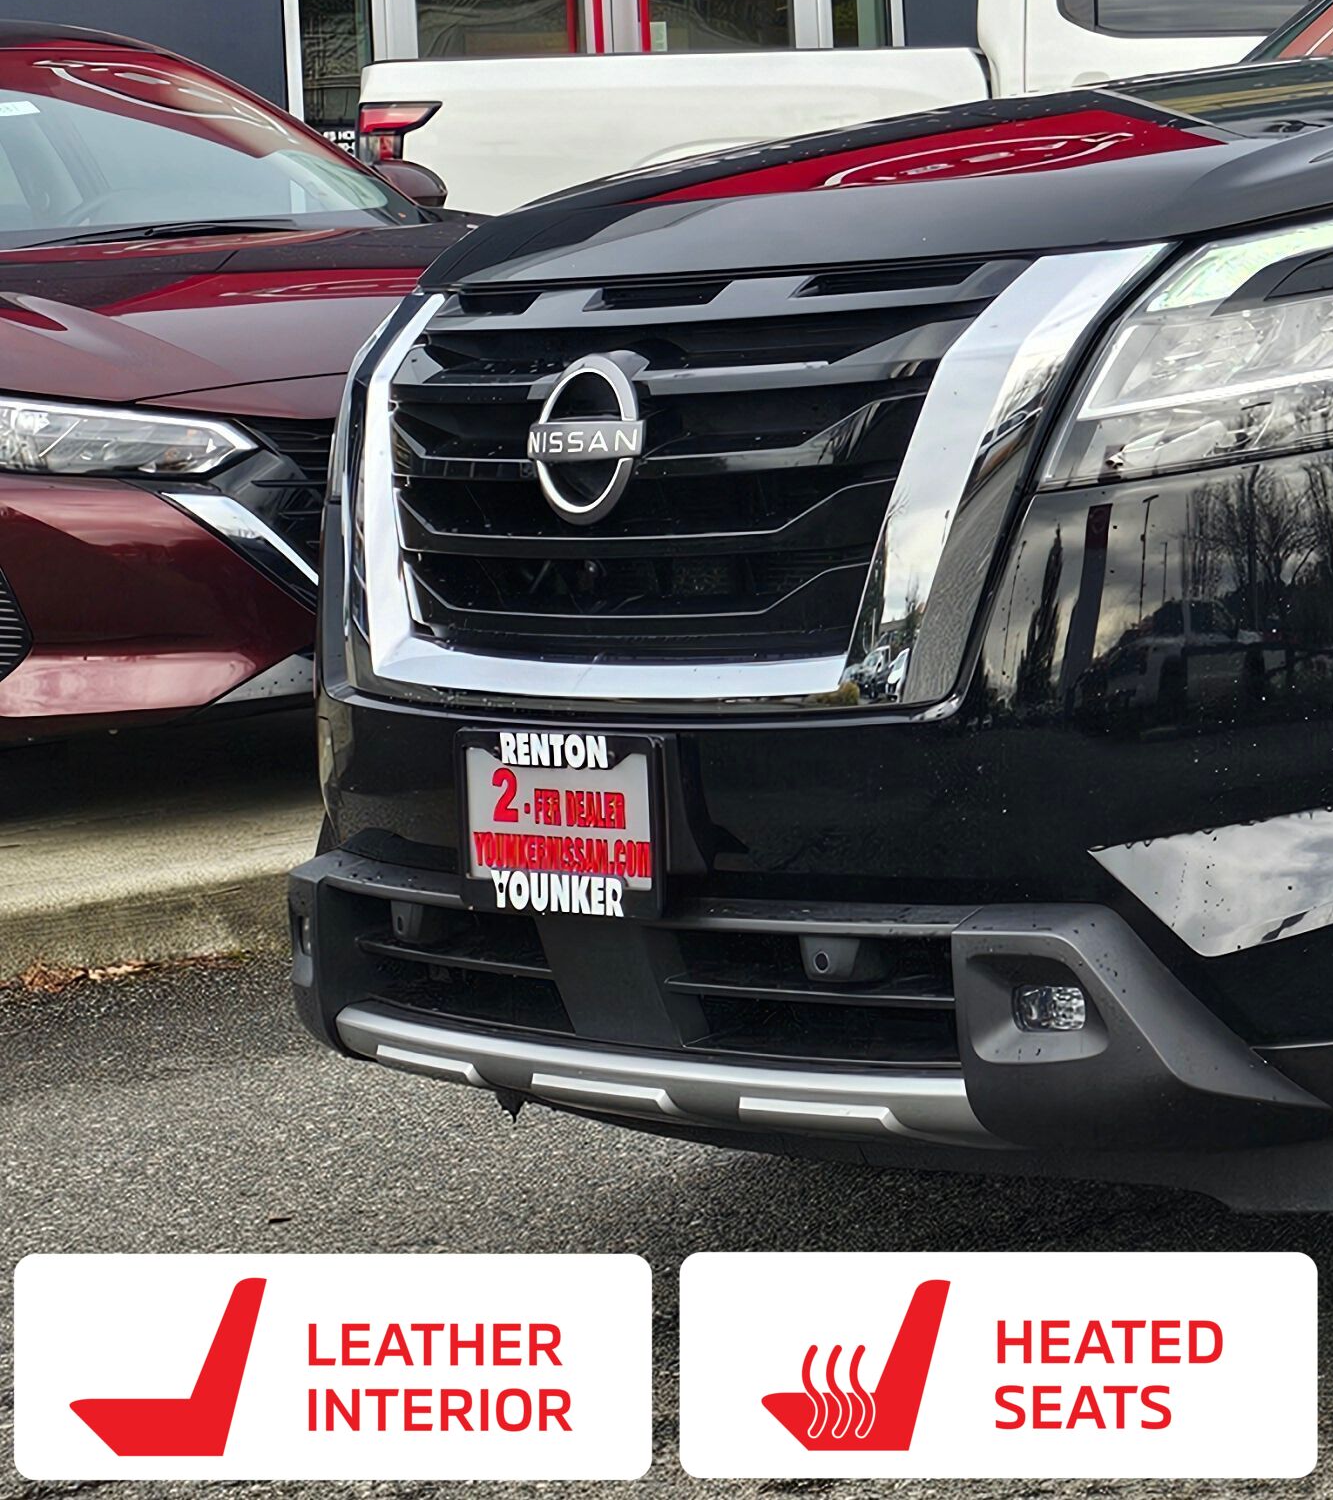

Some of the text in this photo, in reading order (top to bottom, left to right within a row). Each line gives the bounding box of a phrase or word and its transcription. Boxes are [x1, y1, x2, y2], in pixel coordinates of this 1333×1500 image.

[528, 428, 638, 454] NISSAN
[499, 731, 609, 769] RENTON
[565, 789, 627, 830] DEALER
[472, 831, 652, 878] YOUNKERNISSAN.COM
[490, 869, 625, 918] YOUNKER
